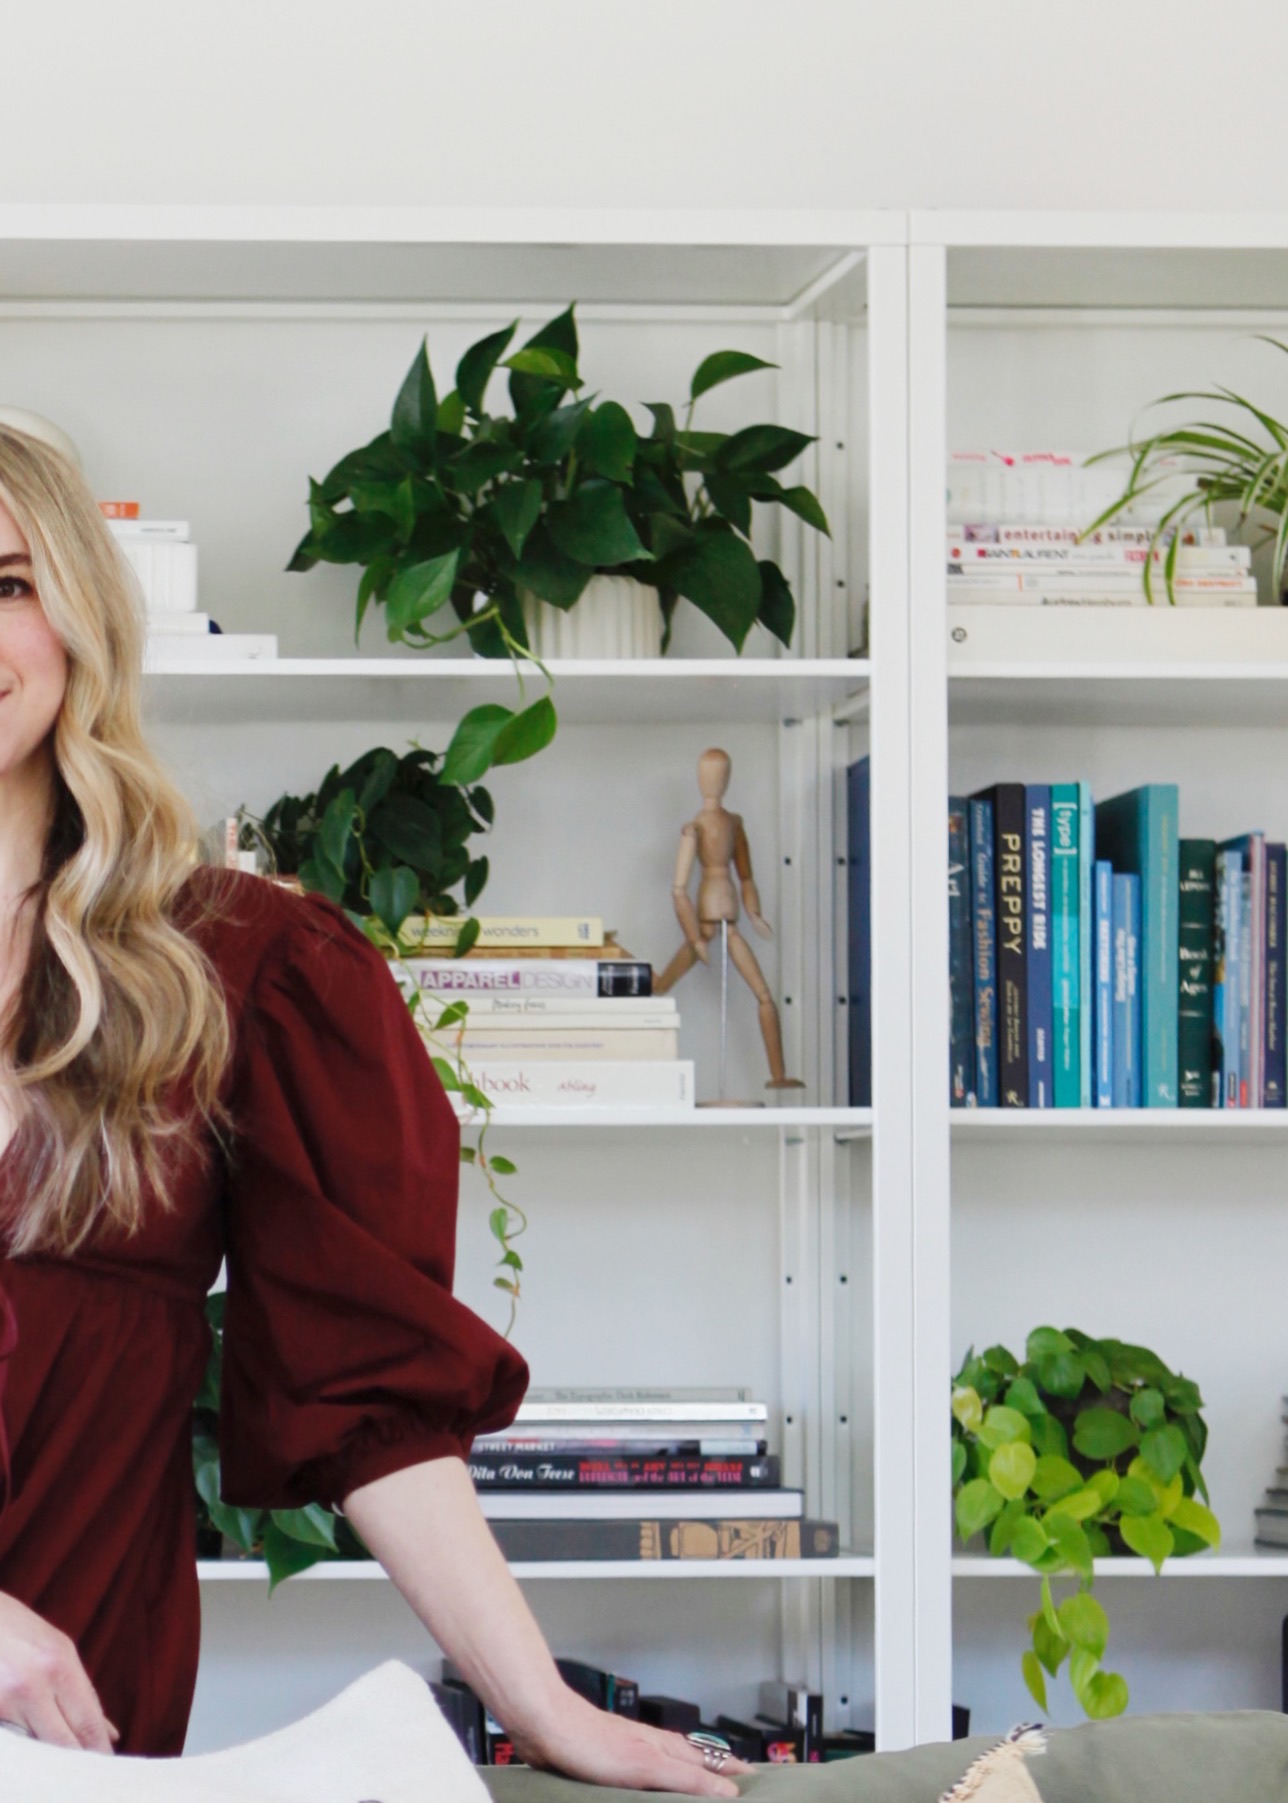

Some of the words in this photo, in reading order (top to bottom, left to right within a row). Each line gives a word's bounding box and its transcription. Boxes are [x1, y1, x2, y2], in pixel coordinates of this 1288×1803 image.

[1004, 528, 1103, 546] entertaing
[1031, 807, 1046, 836] THE
[976, 852, 990, 889] Guide
[1032, 840, 1047, 911] LONGEST
[1000, 834, 1022, 956] PREPPY
[482, 924, 541, 938] wonders
[976, 907, 992, 980] Fashion
[1033, 914, 1047, 950] RIDE
[422, 971, 520, 989] APPAREL
[522, 971, 593, 989] DESIGN
[975, 986, 993, 1049] Sewing
[478, 1441, 514, 1452] STREET
[516, 1441, 556, 1452] MARKET
[538, 1462, 576, 1480] Teese
